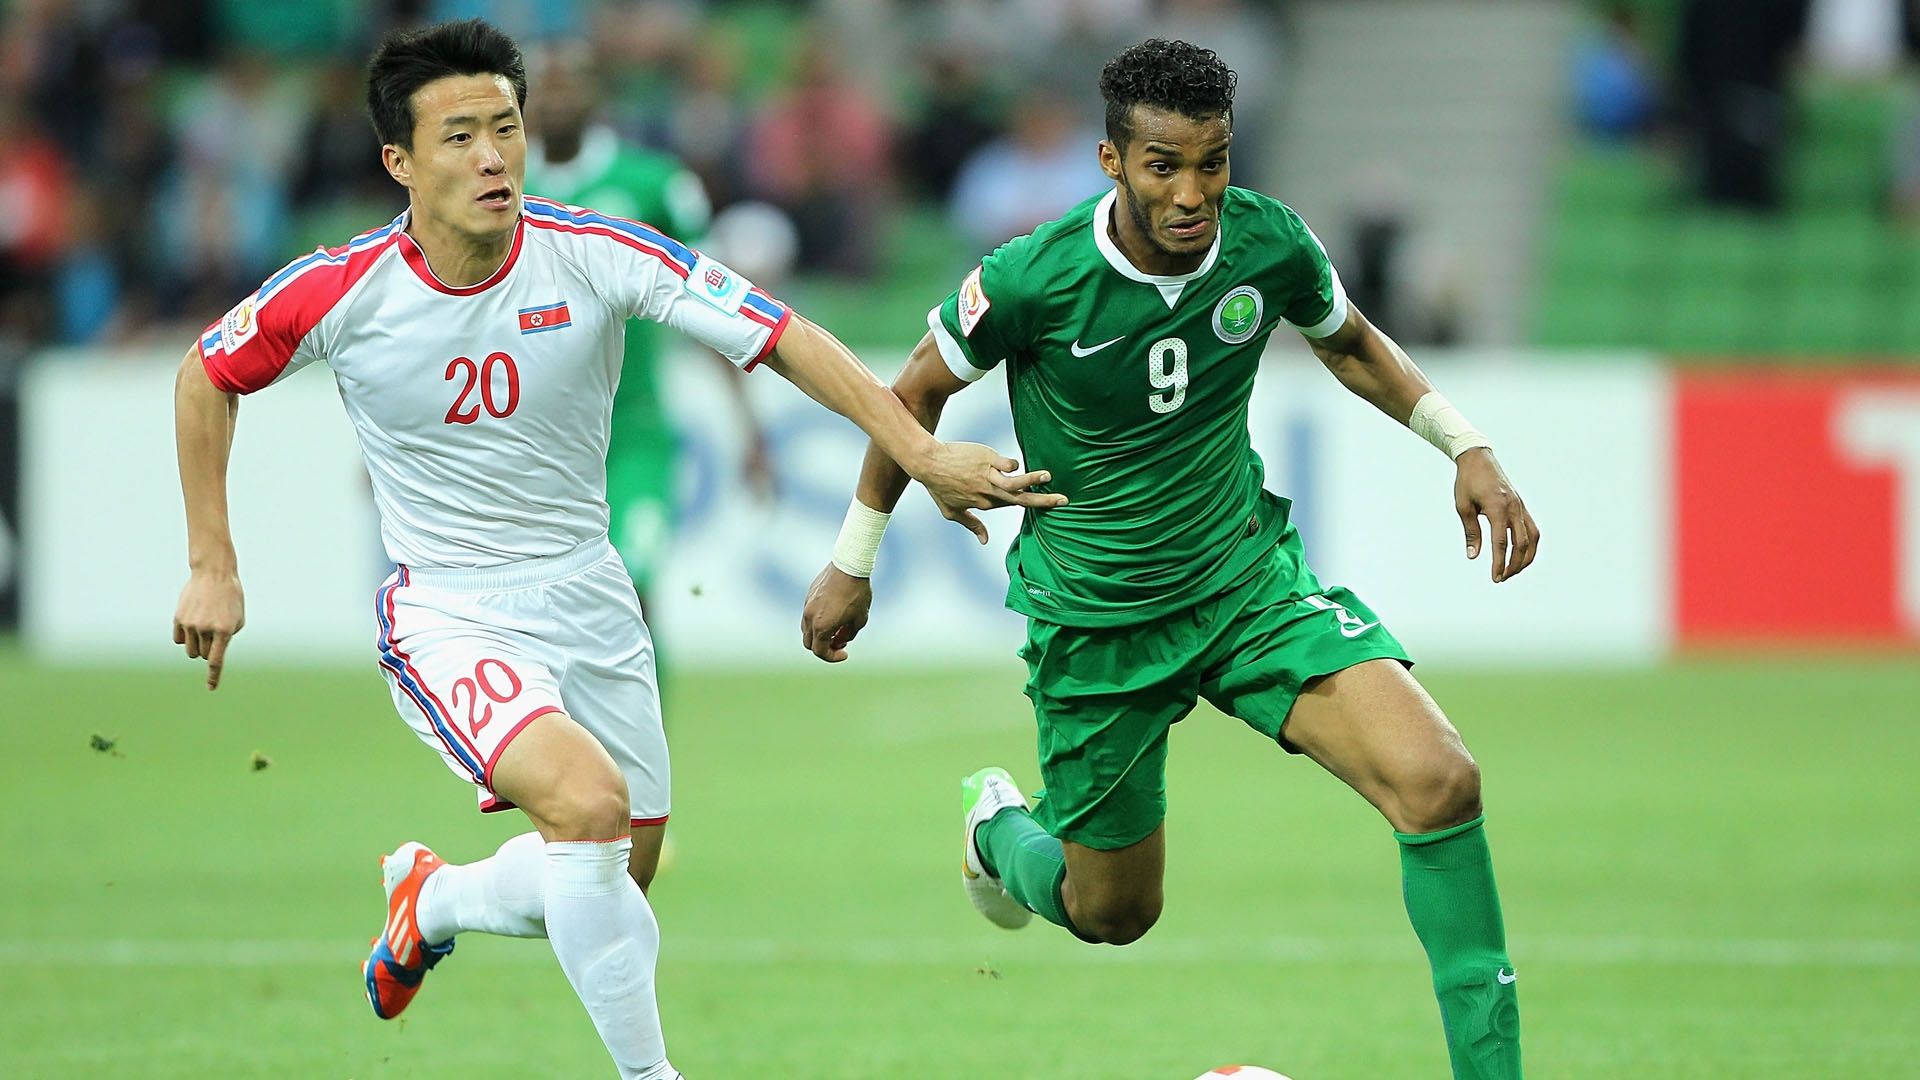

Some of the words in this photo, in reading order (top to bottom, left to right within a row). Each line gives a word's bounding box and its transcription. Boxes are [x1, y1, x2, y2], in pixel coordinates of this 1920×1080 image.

[707, 268, 723, 287] 60
[443, 351, 521, 425] 20
[1148, 337, 1189, 414] 9
[451, 658, 522, 739] 20
